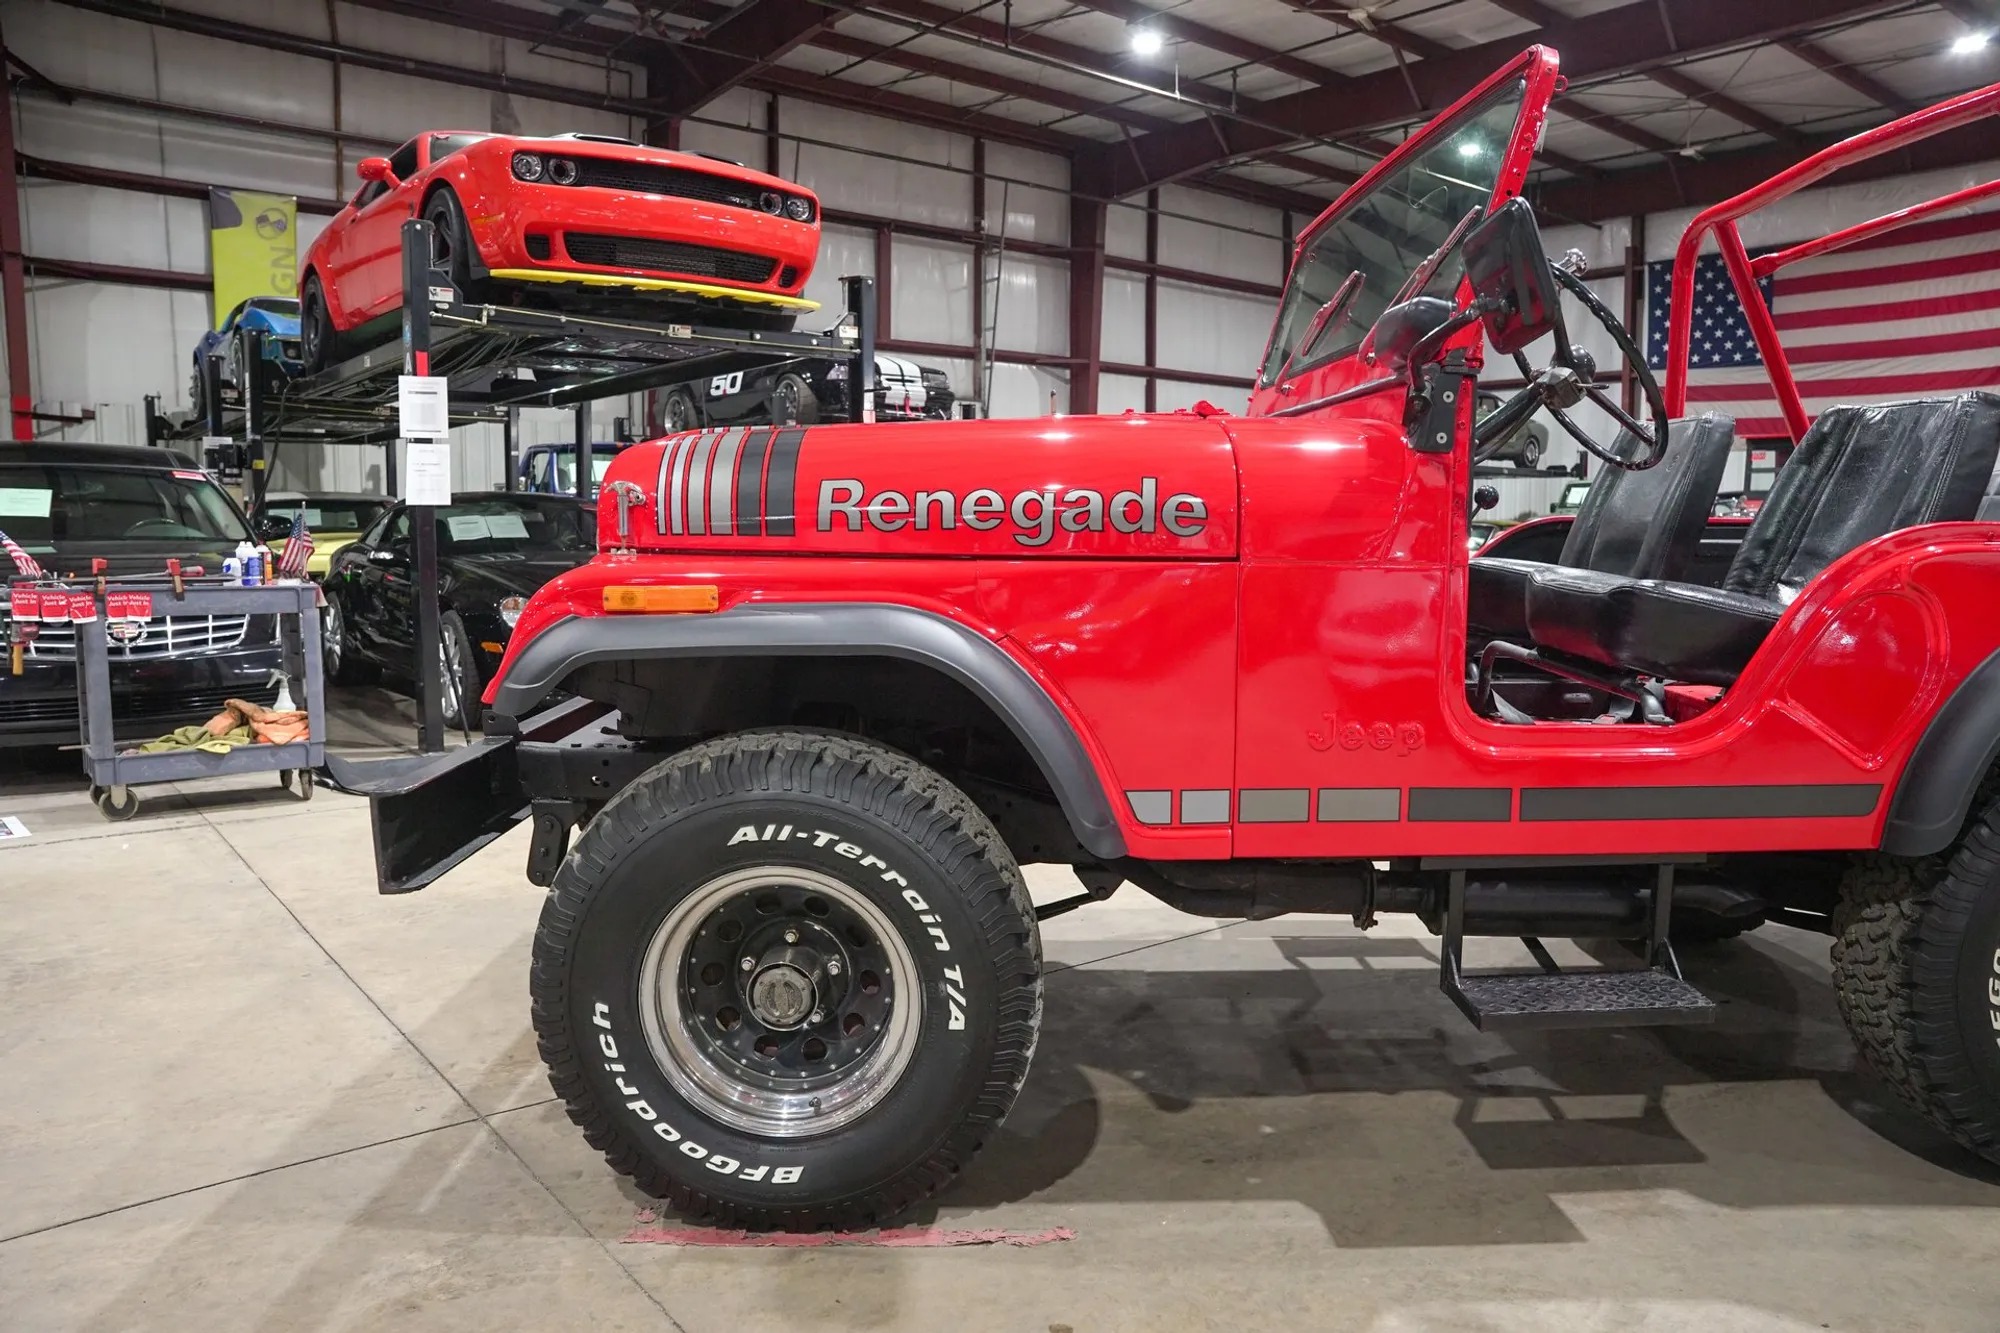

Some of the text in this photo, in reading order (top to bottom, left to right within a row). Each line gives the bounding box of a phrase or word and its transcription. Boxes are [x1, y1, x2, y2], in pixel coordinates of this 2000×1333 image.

[816, 476, 1209, 547] Renegade
[1307, 711, 1426, 758] Jeep
[727, 824, 950, 951] All-Terrain
[943, 964, 967, 1030] T/A
[593, 1002, 805, 1184] BFGoodrich
